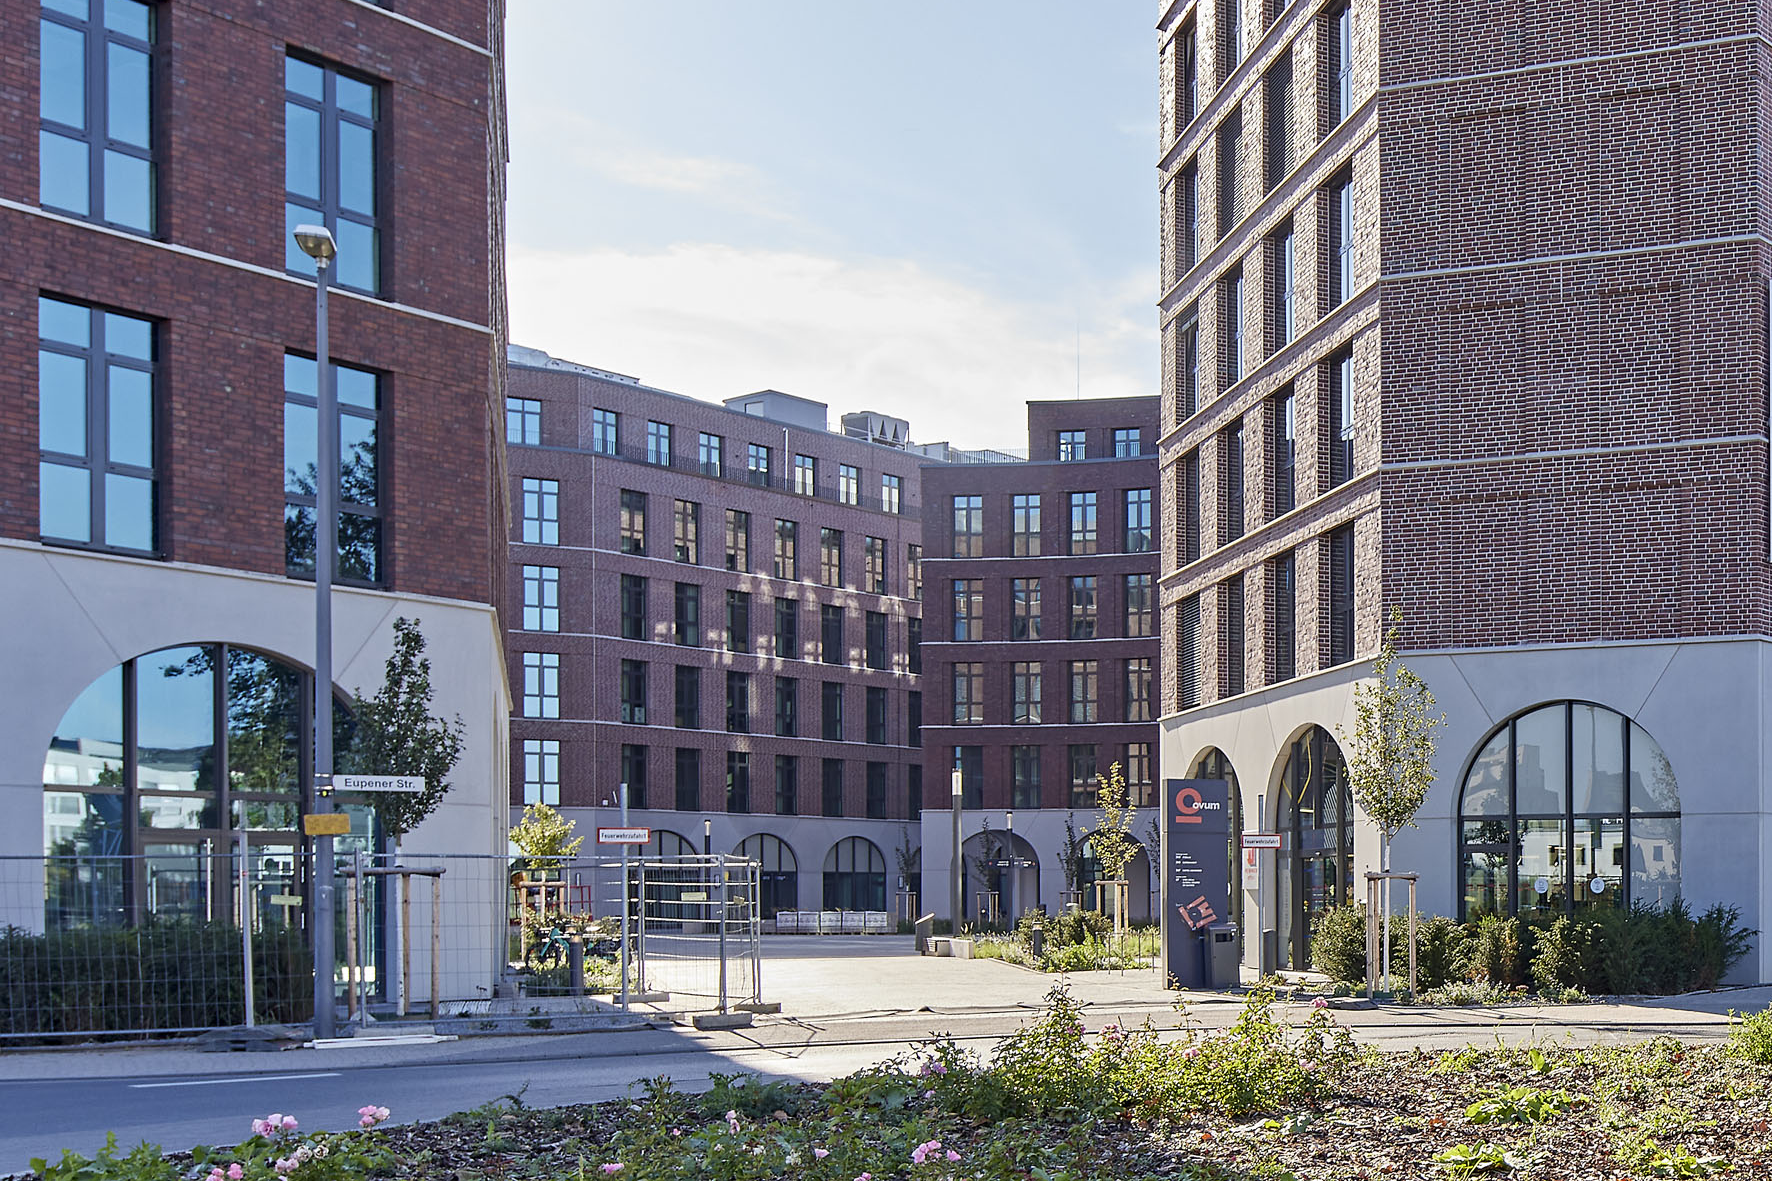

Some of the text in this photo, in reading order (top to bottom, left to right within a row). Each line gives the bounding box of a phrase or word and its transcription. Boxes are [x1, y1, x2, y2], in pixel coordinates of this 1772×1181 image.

[344, 778, 416, 790] Eupener Str.
[1192, 802, 1220, 810] ovum
